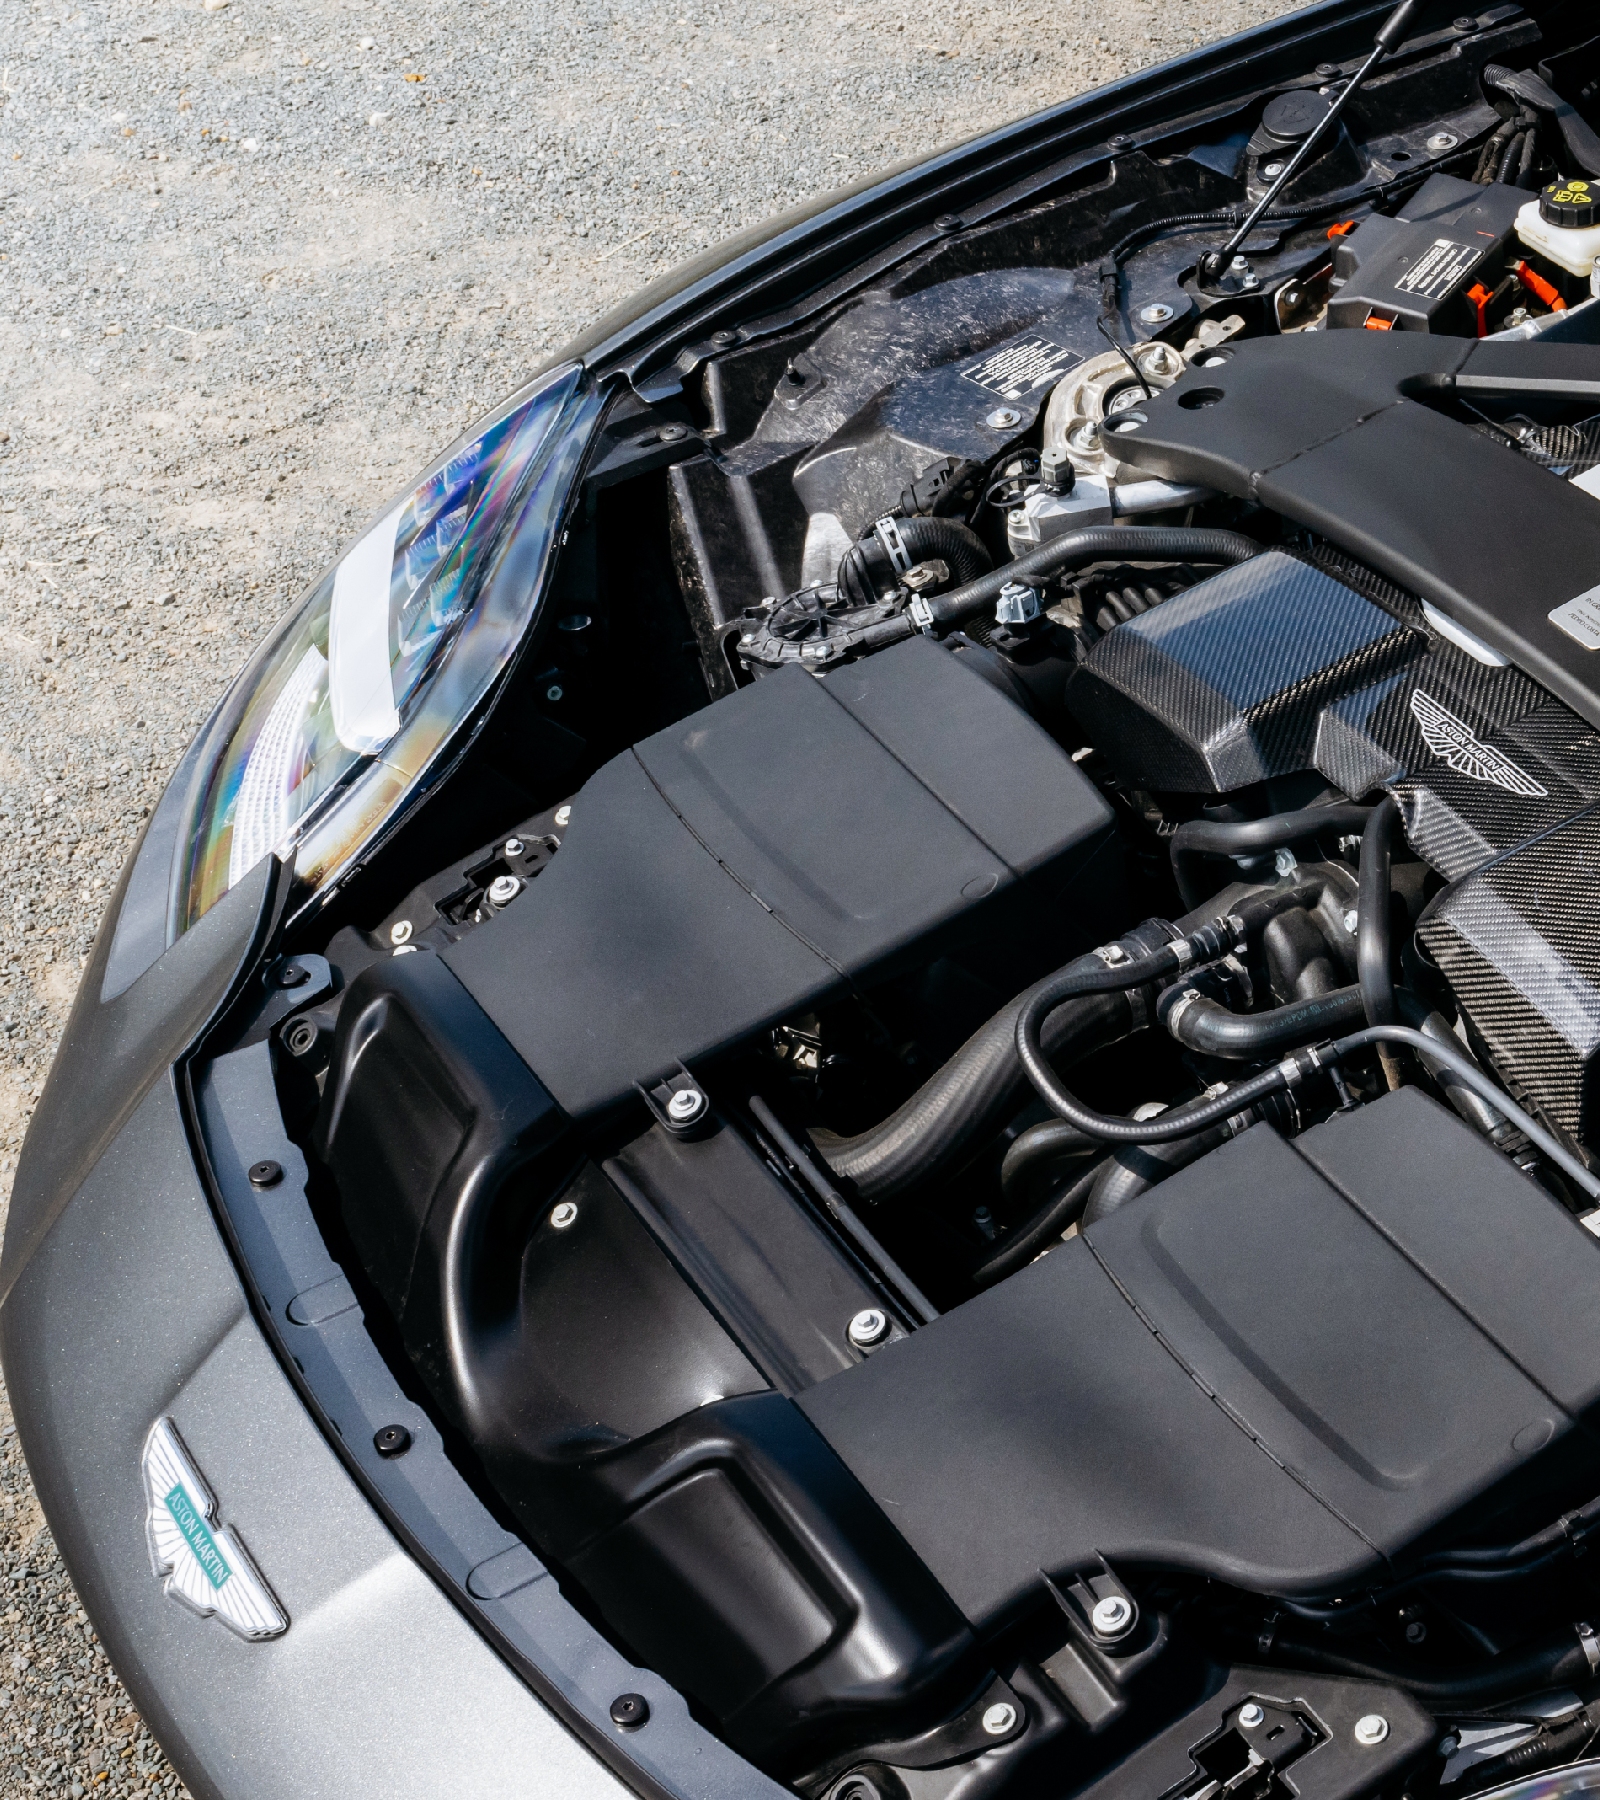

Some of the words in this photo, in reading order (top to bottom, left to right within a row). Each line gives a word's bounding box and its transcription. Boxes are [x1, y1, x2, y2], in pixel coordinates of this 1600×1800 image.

[1438, 724, 1469, 745] ASTON
[1465, 743, 1499, 770] MARTIN
[168, 1491, 200, 1536] ASTON
[191, 1530, 229, 1585] MARTIN
